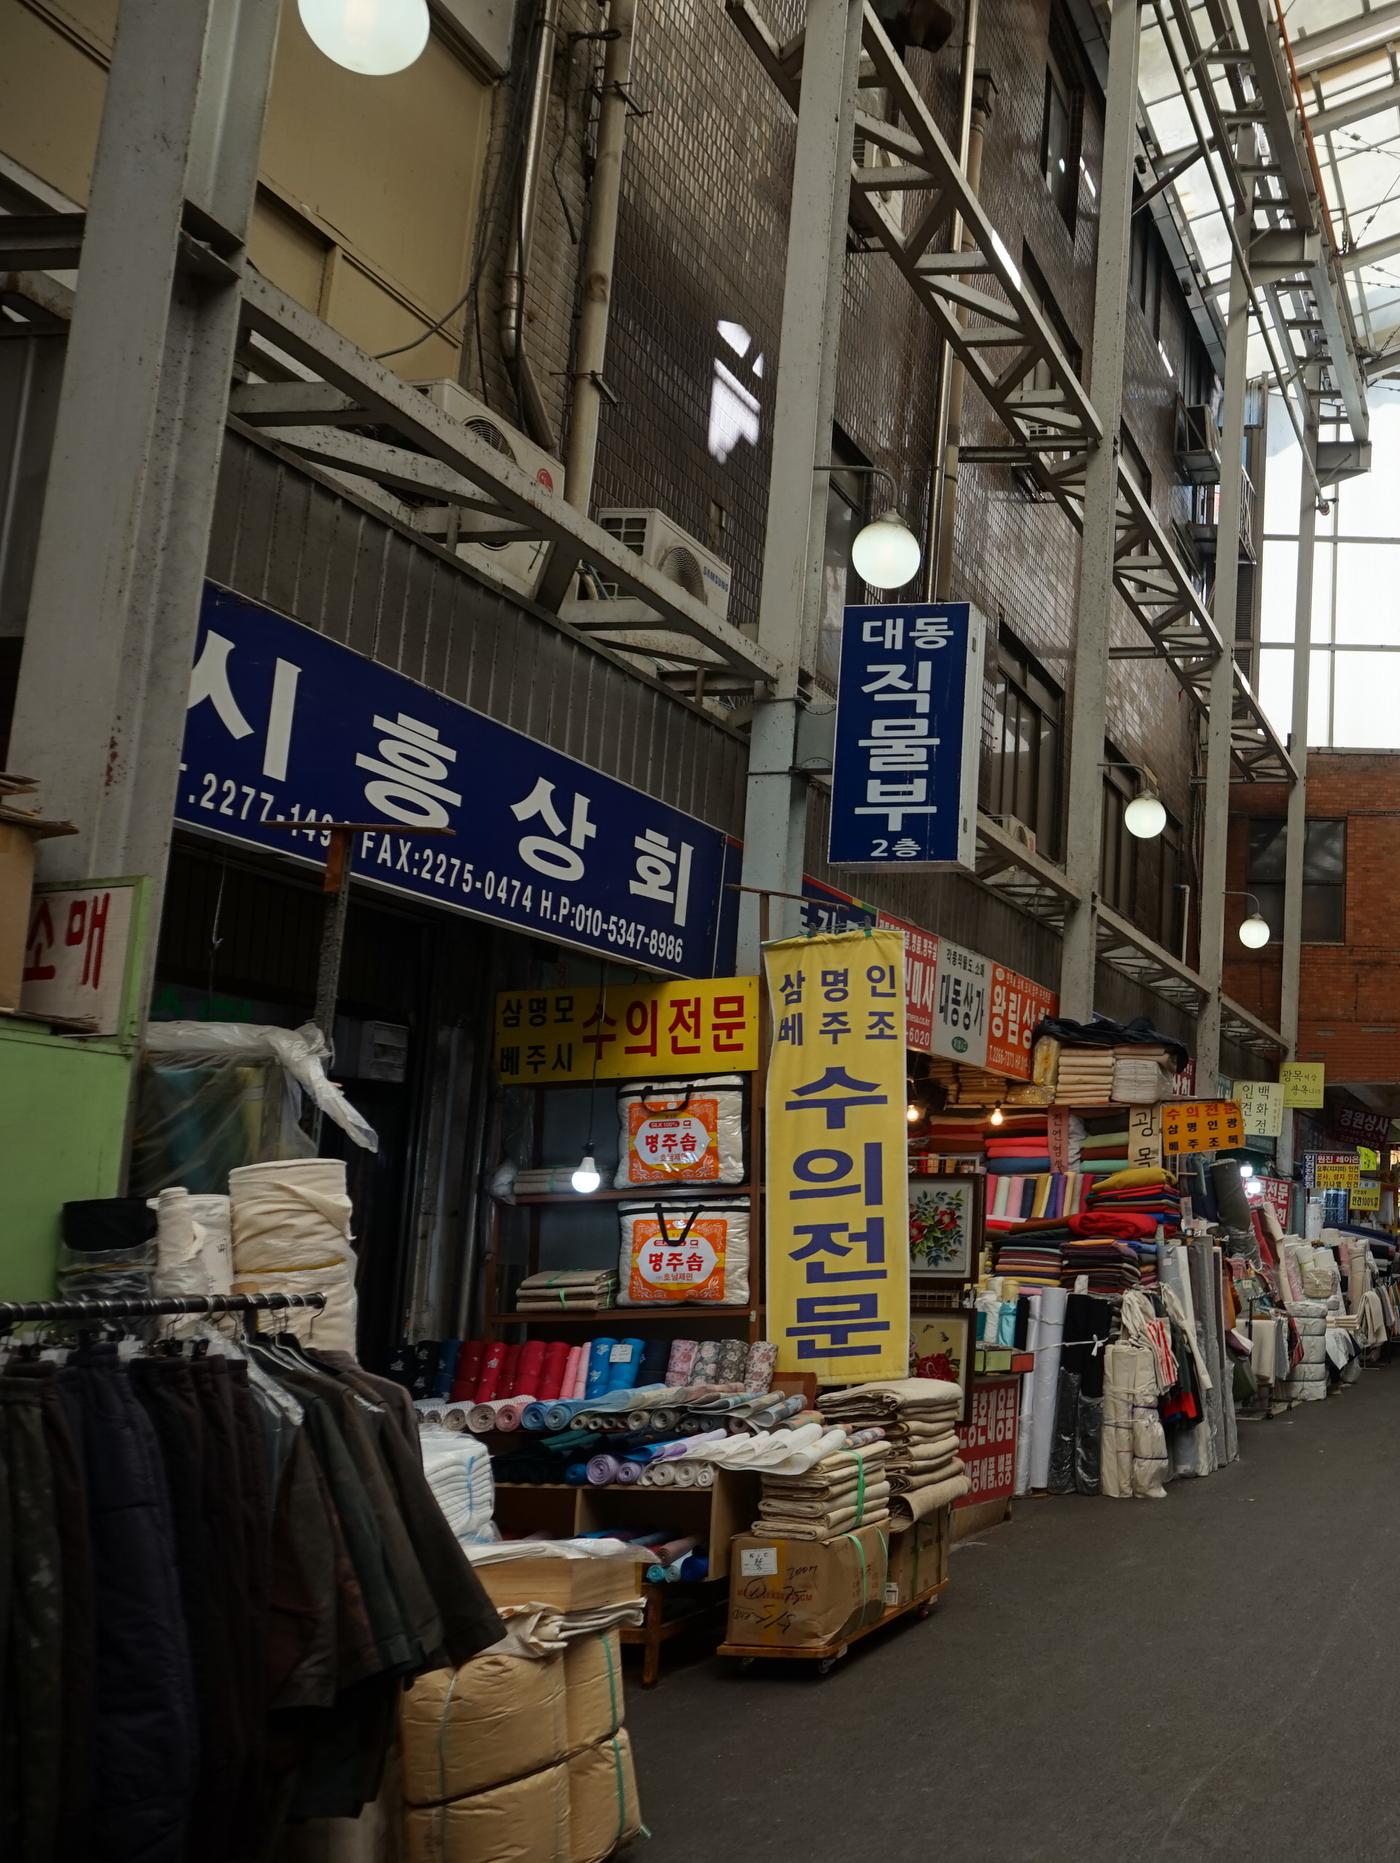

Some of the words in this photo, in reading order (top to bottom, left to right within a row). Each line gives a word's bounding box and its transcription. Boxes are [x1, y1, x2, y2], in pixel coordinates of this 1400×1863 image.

[861, 617, 954, 650] 대동
[186, 629, 694, 927] 시흥상회
[854, 661, 940, 832] 직물부
[870, 838, 921, 857] 2층
[361, 830, 533, 910] FAX:2275-0474
[540, 887, 683, 964] H.P:010-5347-8986
[23, 892, 111, 990] 소매
[583, 995, 746, 1060] 수의전문
[939, 974, 985, 1037] 대동상가
[1132, 1107, 1156, 1168] 광목
[1167, 1102, 1239, 1120] 수의전문
[645, 1133, 697, 1153] 명주솜
[785, 1066, 890, 1361] 수의전문
[648, 1252, 704, 1273] 명주솜
